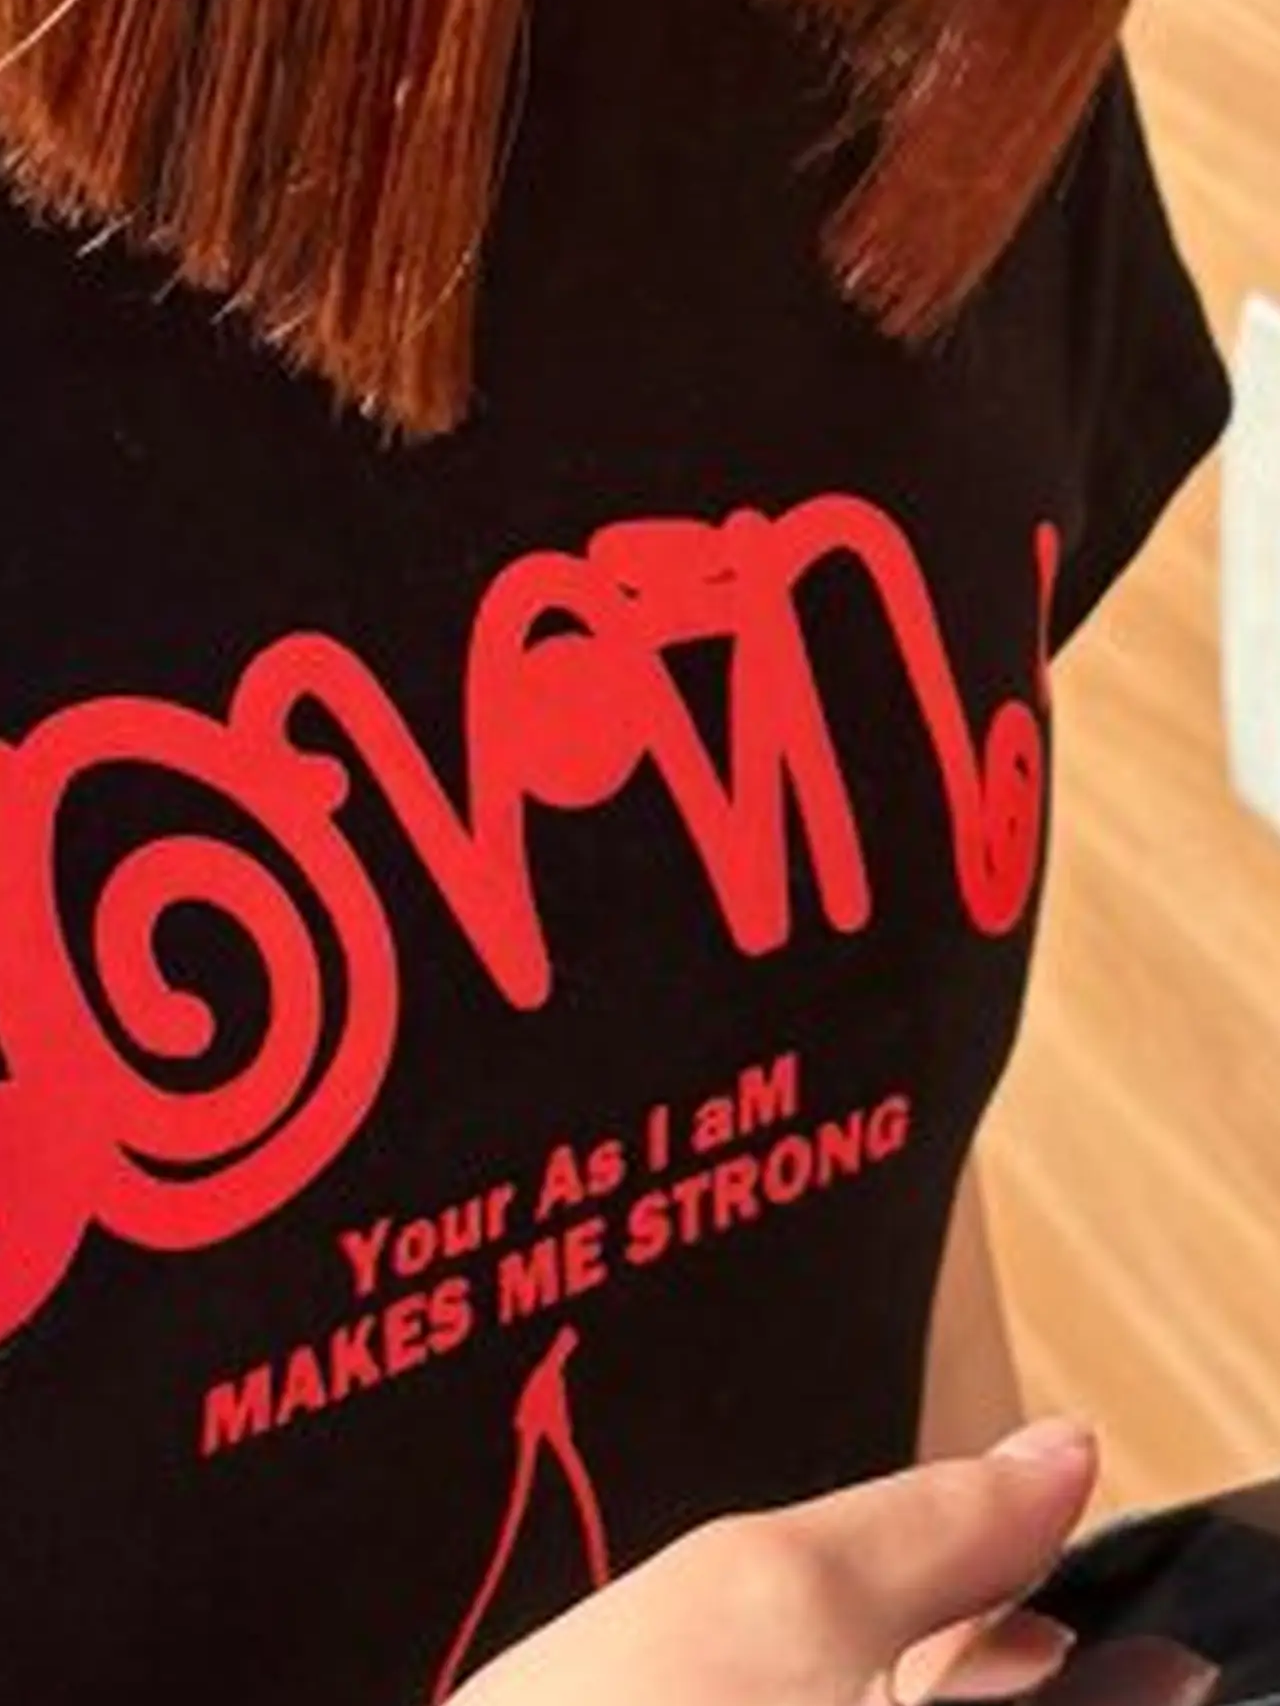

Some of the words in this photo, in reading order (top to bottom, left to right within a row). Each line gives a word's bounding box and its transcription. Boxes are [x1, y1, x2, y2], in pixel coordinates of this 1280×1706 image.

[198, 1275, 475, 1456] MAKES
[496, 1216, 609, 1325] ME
[623, 1096, 911, 1267] STRONG
[337, 1182, 516, 1298] Your
[533, 1138, 624, 1222] As
[645, 1104, 671, 1171] I
[689, 1052, 799, 1154] aM
